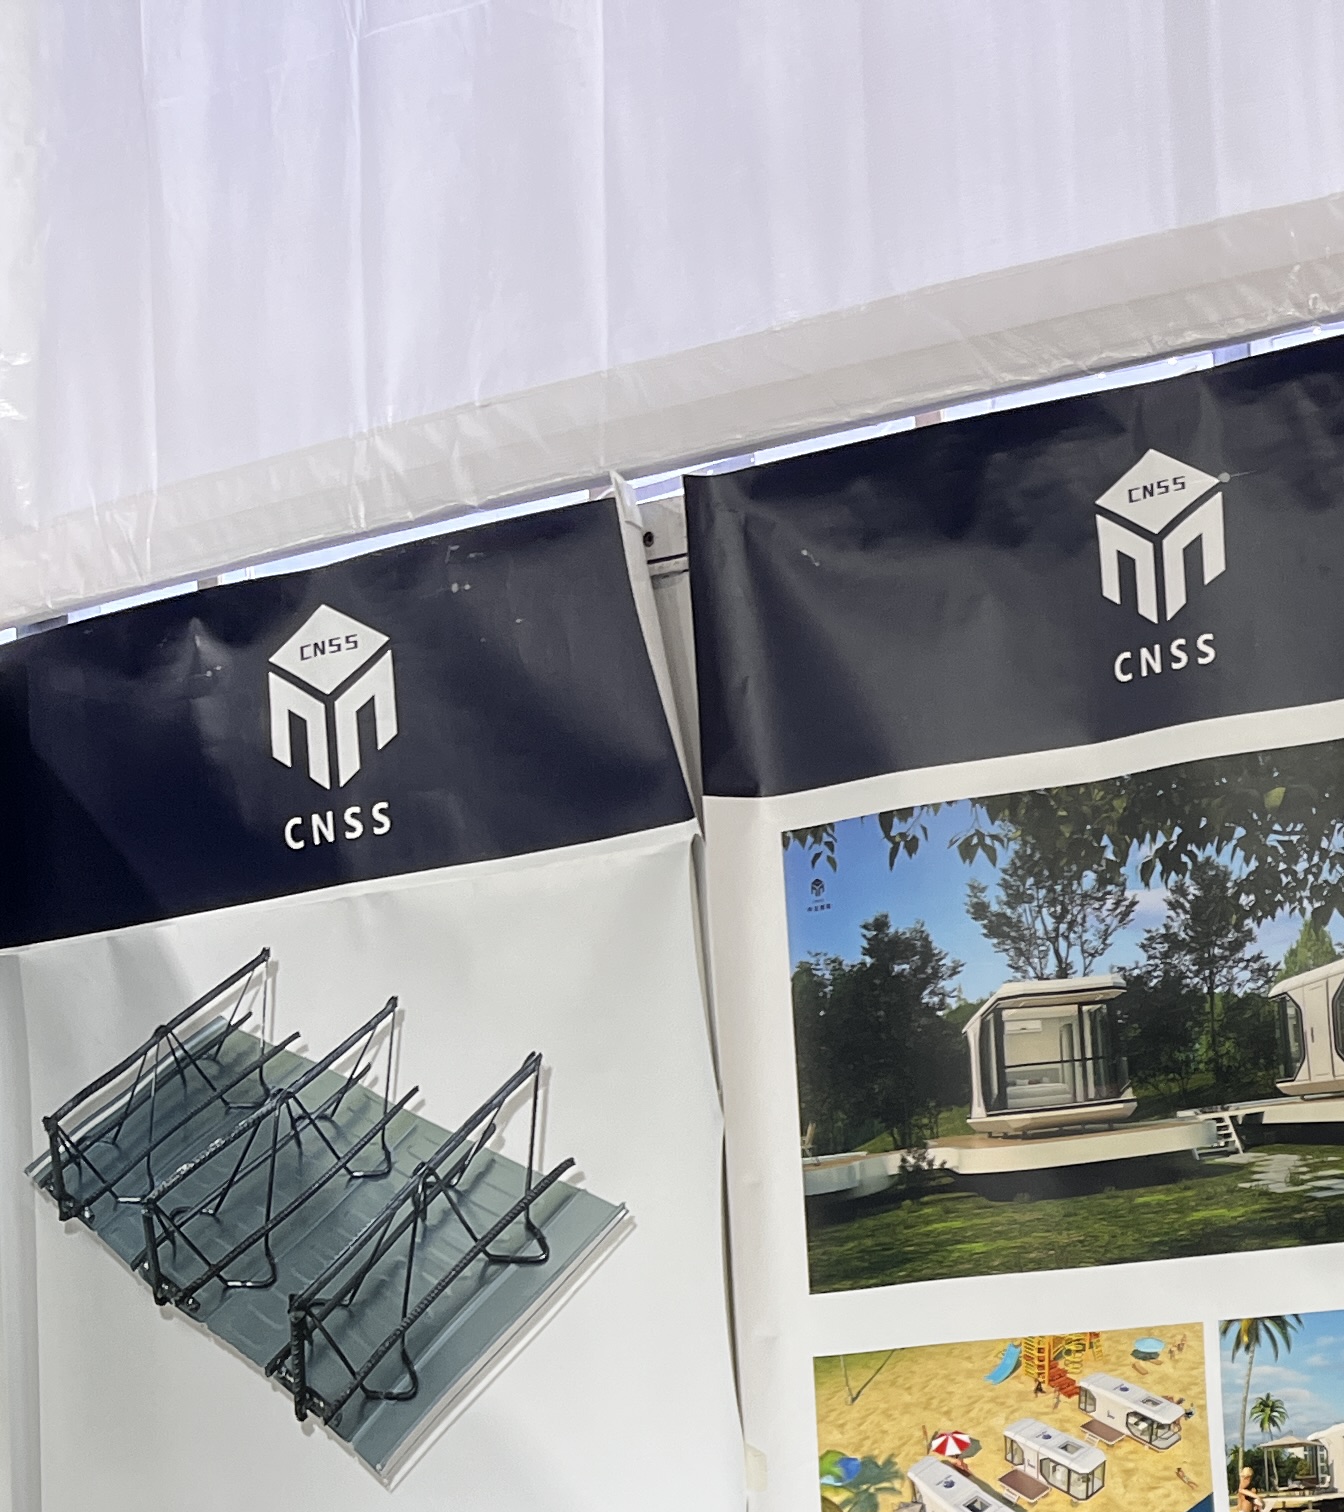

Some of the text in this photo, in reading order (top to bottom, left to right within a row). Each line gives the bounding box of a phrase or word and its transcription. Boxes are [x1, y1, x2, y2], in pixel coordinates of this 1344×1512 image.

[1128, 476, 1187, 503] CNSS
[300, 634, 358, 661] CNSS
[1114, 633, 1216, 682] CNSS
[284, 802, 392, 849] CNSS
